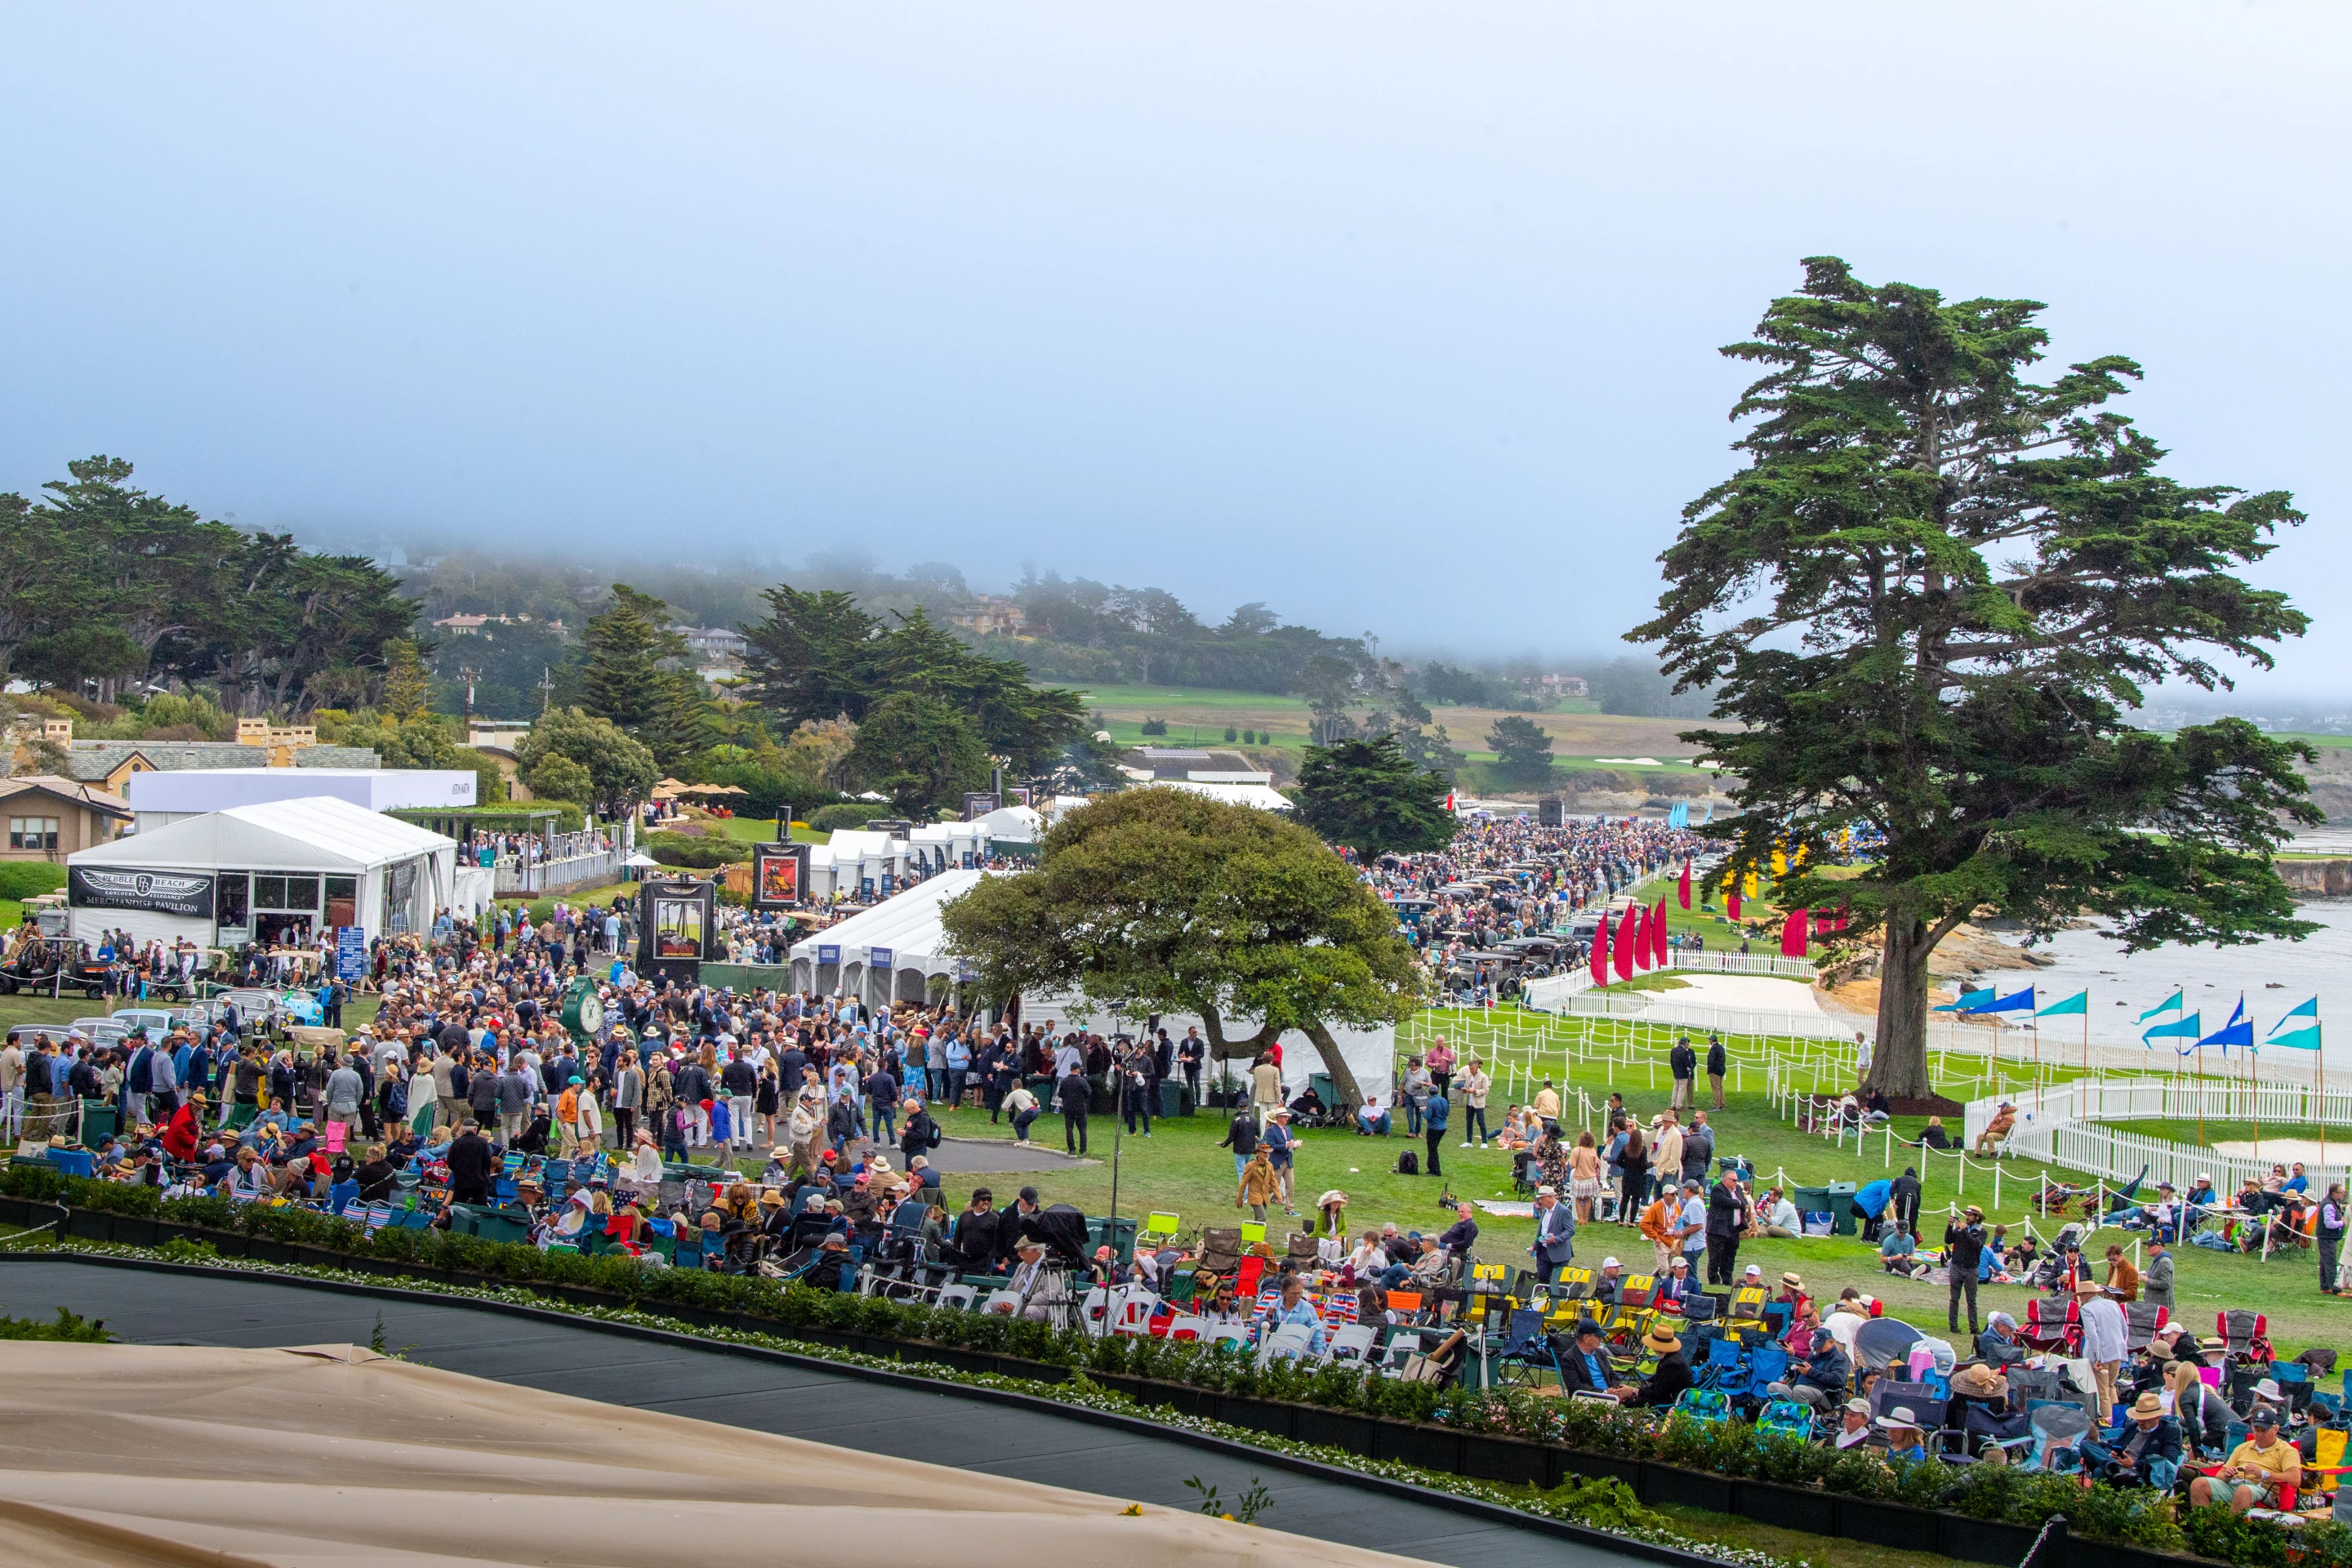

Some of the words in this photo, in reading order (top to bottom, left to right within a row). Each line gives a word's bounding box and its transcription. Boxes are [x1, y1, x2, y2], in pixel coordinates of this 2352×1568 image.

[103, 875, 135, 884] PEBBLE
[154, 879, 185, 888] BEACH
[86, 896, 153, 909] MERCHANDISE
[155, 901, 198, 913] PAVILION
[821, 949, 836, 959] COCKTAILS
[1482, 1266, 1497, 1276] O
[1568, 1269, 1584, 1280] O
[1633, 1276, 1647, 1287] O
[1744, 1289, 1758, 1301] O
